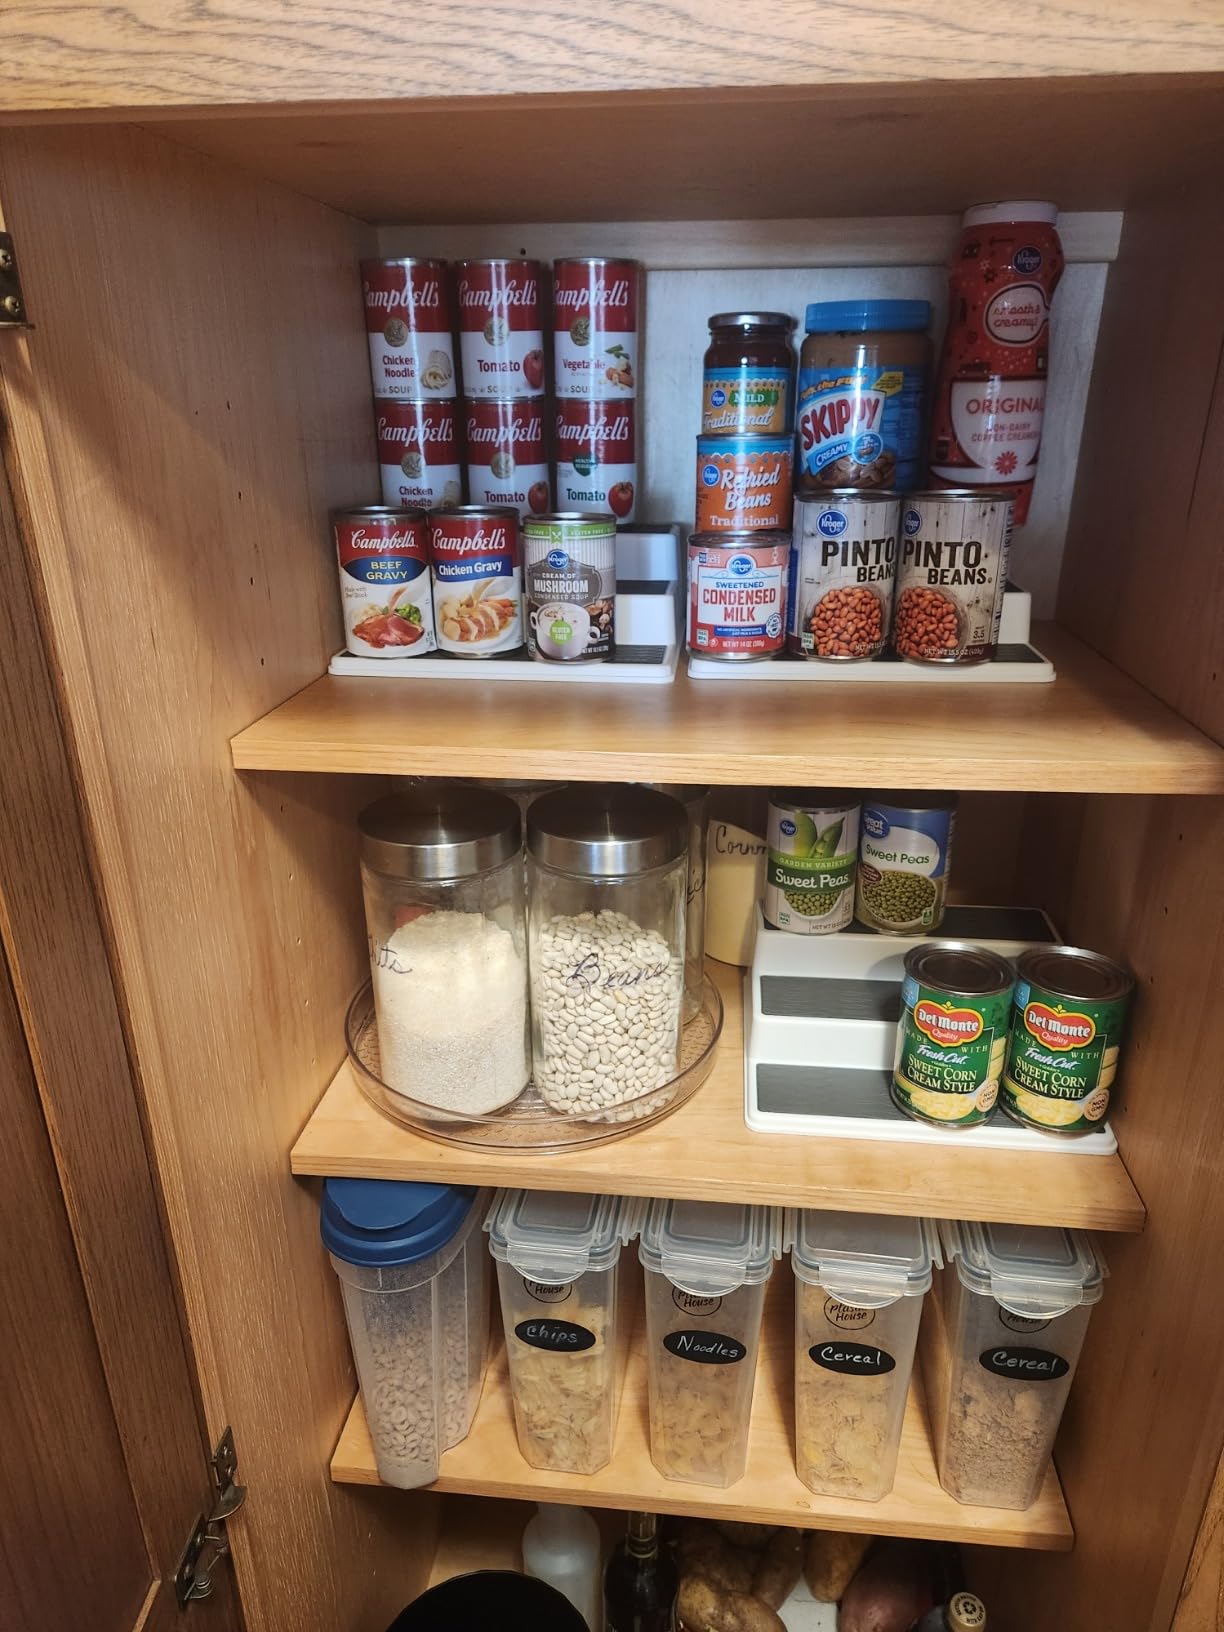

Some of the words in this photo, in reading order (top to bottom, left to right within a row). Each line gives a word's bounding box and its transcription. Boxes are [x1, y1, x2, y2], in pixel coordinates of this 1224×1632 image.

[384, 367, 415, 378] Noodle
[477, 359, 521, 373] Tomato
[563, 358, 606, 372] Vegetale
[734, 393, 765, 403] MILD
[467, 418, 542, 448] Campbell's
[801, 398, 880, 451] SKIPPY
[815, 441, 849, 466] CREAMY
[399, 486, 434, 497] Chicken
[485, 491, 526, 503] Tomato
[566, 488, 606, 501] Tomato
[724, 491, 772, 511] Beans
[710, 516, 779, 527] Traditional
[821, 515, 845, 532] Kroger
[351, 529, 416, 552] Campbell's
[433, 528, 506, 555] Campbell's
[821, 537, 895, 566] PINTO
[902, 539, 982, 568] PINTO
[371, 561, 402, 569] BEEF
[438, 564, 473, 577] Chicken
[474, 561, 502, 575] Gravy
[366, 571, 408, 580] GRAVY
[534, 579, 589, 593] MUSHROOM
[703, 587, 776, 605] CONDENSED
[724, 607, 756, 622] MILK
[973, 630, 985, 639] 3.5
[865, 844, 897, 862] Sweet
[901, 853, 930, 864] Peas
[775, 869, 817, 889] Sweet
[820, 873, 849, 888] Peas
[566, 953, 669, 992] Beans
[918, 1008, 937, 1026] Del
[938, 1017, 979, 1032] Monte
[1028, 1010, 1046, 1028] Del
[1047, 1019, 1091, 1038] Monte
[932, 1028, 959, 1041] Quality
[1041, 1031, 1069, 1045] Quality
[917, 1044, 945, 1061] Fresh
[1024, 1046, 1053, 1065] Fresh
[908, 1053, 942, 1077] SWEET
[943, 1067, 977, 1081] CORN
[1016, 1055, 1050, 1081] SWEET
[1051, 1070, 1087, 1088] CORN
[907, 1066, 941, 1090] CREAM
[943, 1079, 976, 1093] STYLE
[1014, 1067, 1048, 1095] CREAM
[1050, 1082, 1085, 1099] STYLE
[534, 1284, 565, 1295] House
[683, 1297, 715, 1308] House
[834, 1310, 868, 1322] House
[526, 1324, 579, 1345] Chips
[676, 1335, 739, 1359] Noodles
[821, 1346, 882, 1367] Cereal
[992, 1350, 1057, 1373] Cereal
